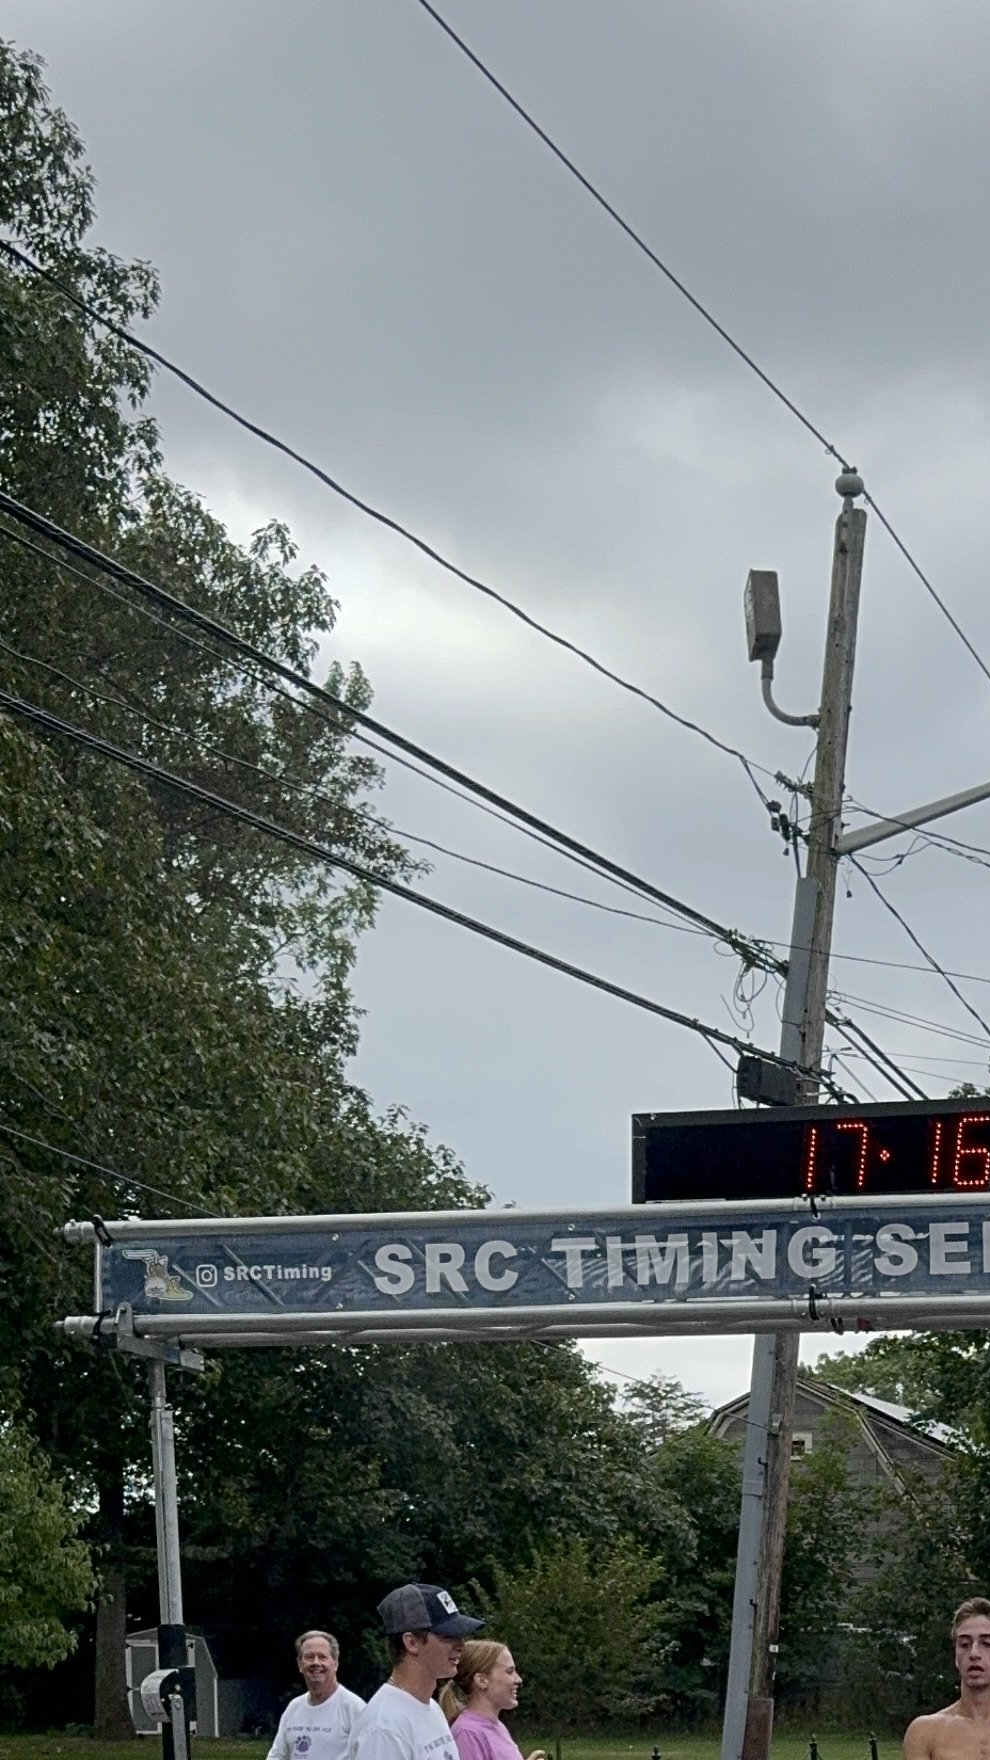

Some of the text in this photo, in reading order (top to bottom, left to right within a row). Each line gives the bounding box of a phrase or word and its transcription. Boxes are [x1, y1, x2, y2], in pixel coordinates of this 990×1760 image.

[223, 1264, 332, 1281] SRCTiming
[374, 1240, 519, 1294] SRC
[551, 1226, 837, 1289] TIMING
